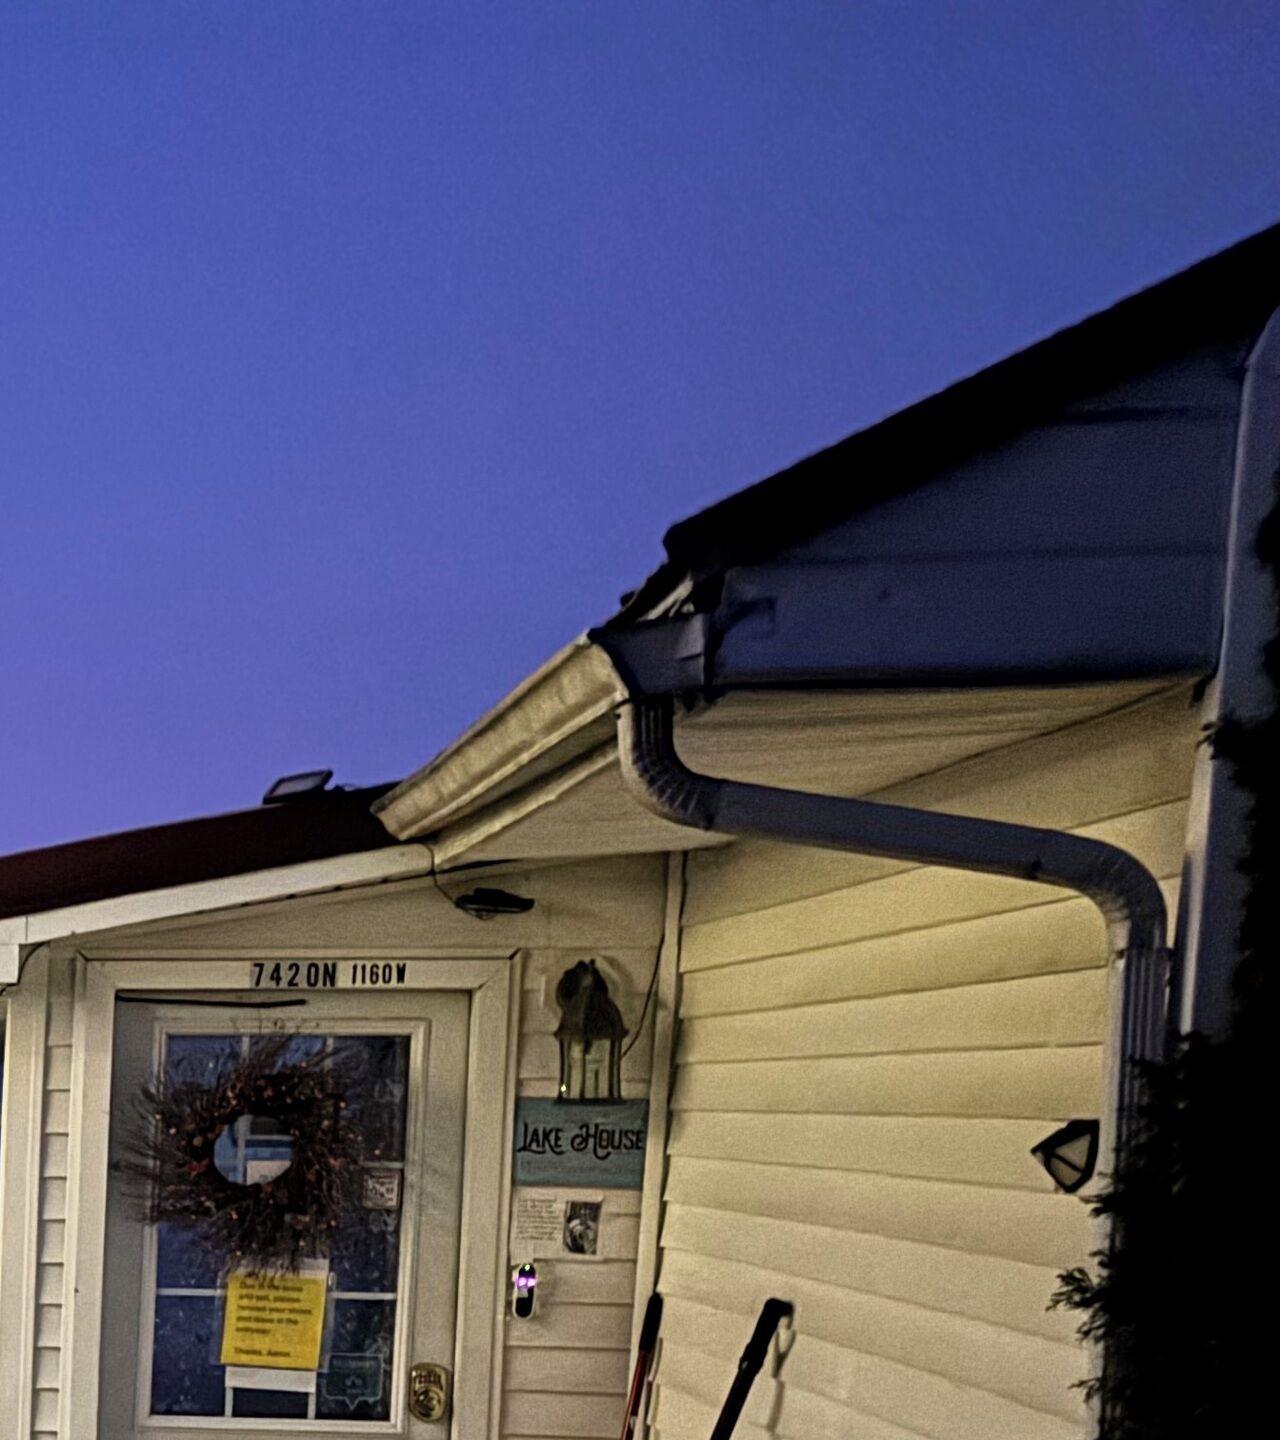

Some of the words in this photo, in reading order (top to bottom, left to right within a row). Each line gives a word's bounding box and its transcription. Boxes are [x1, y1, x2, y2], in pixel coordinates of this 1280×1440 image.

[351, 962, 407, 986] 1160W
[517, 1122, 566, 1155] LAKE
[570, 1122, 646, 1161] HOUSE
